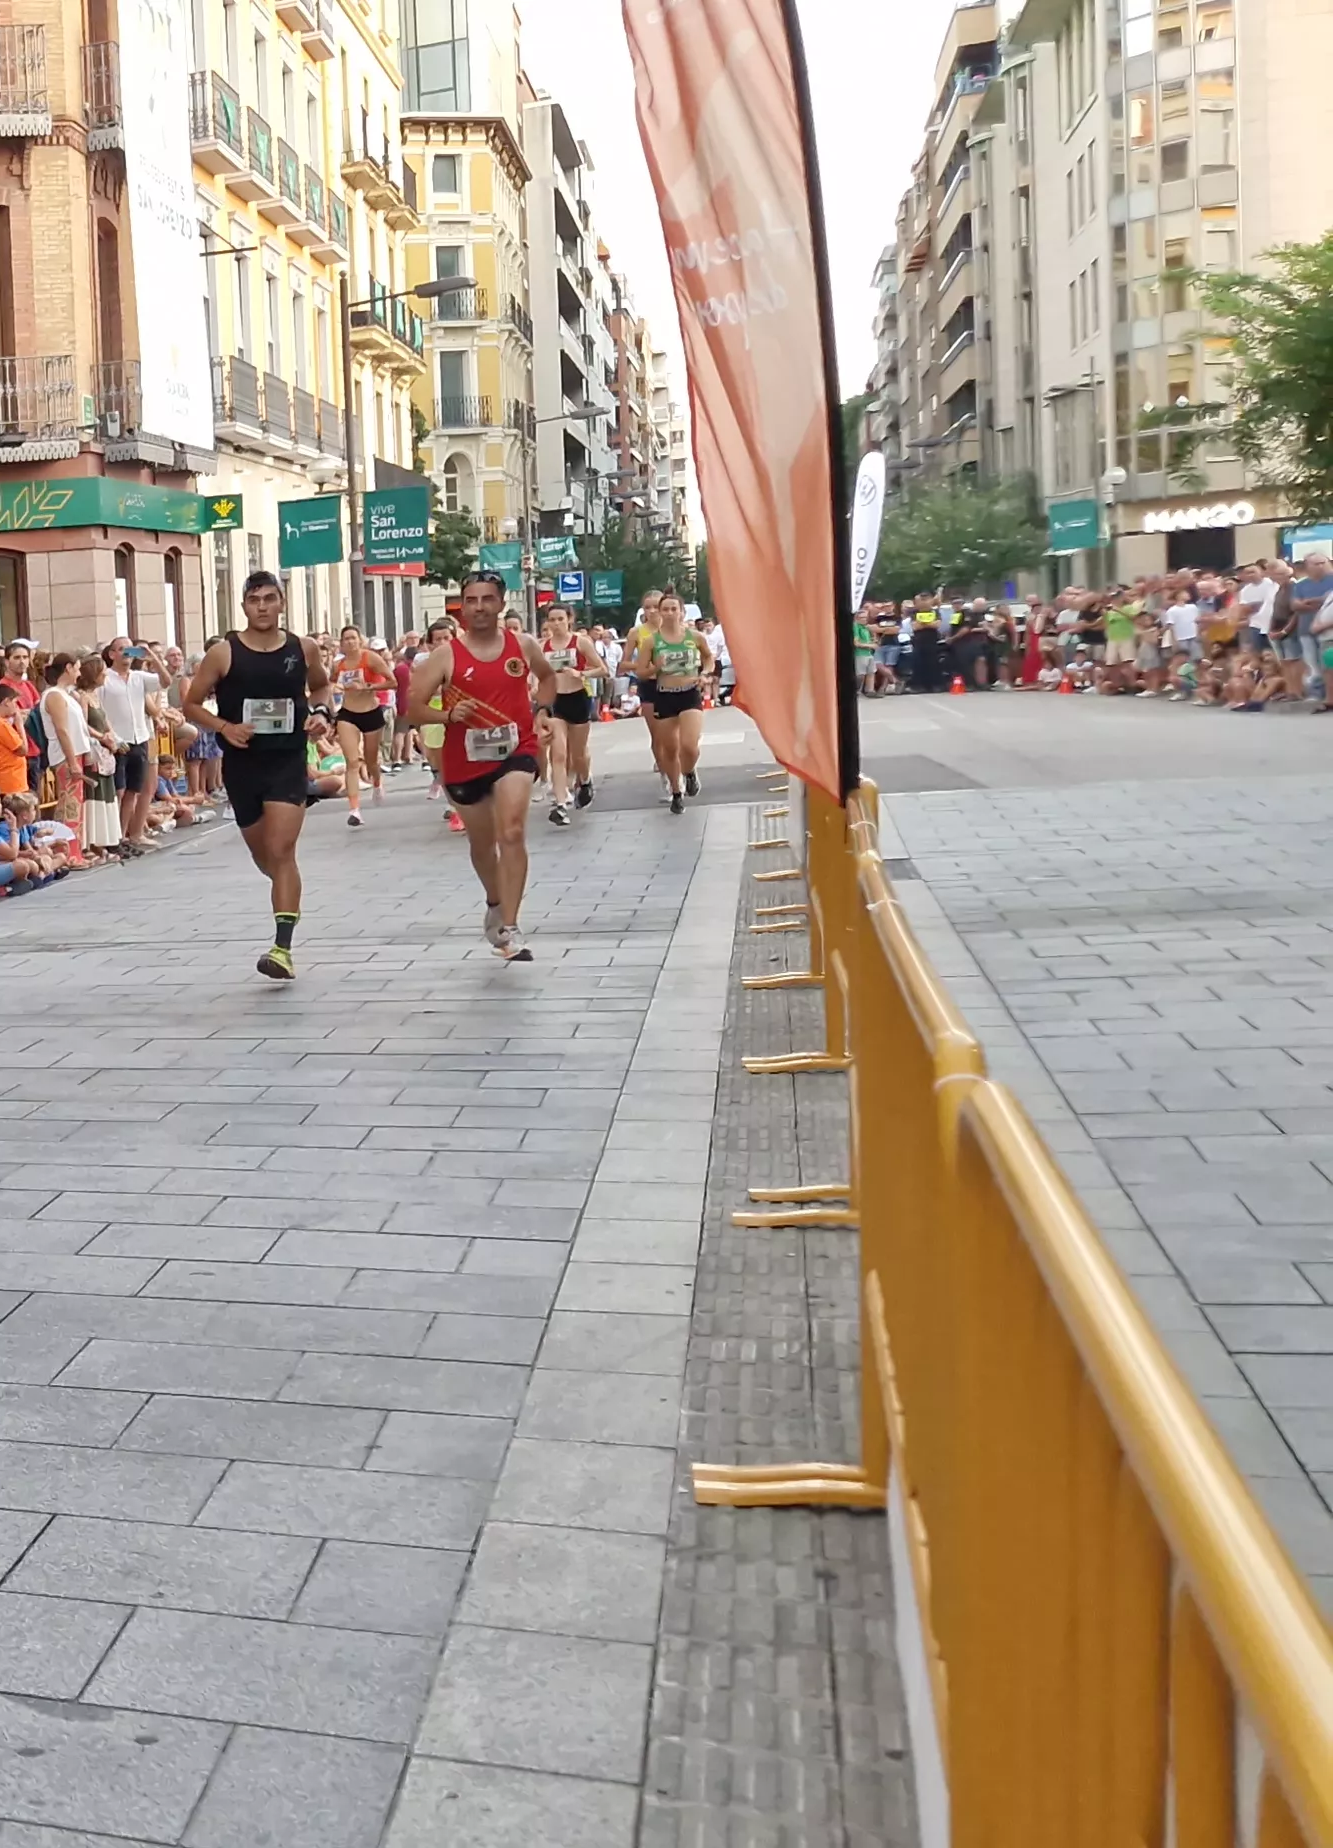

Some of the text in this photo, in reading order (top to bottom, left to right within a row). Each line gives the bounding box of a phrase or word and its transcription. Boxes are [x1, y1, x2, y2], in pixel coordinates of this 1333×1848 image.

[370, 502, 396, 515] vive
[370, 515, 396, 528] San
[1144, 501, 1255, 533] MANGO
[371, 527, 424, 541] Lorenzo
[264, 701, 274, 713] 3
